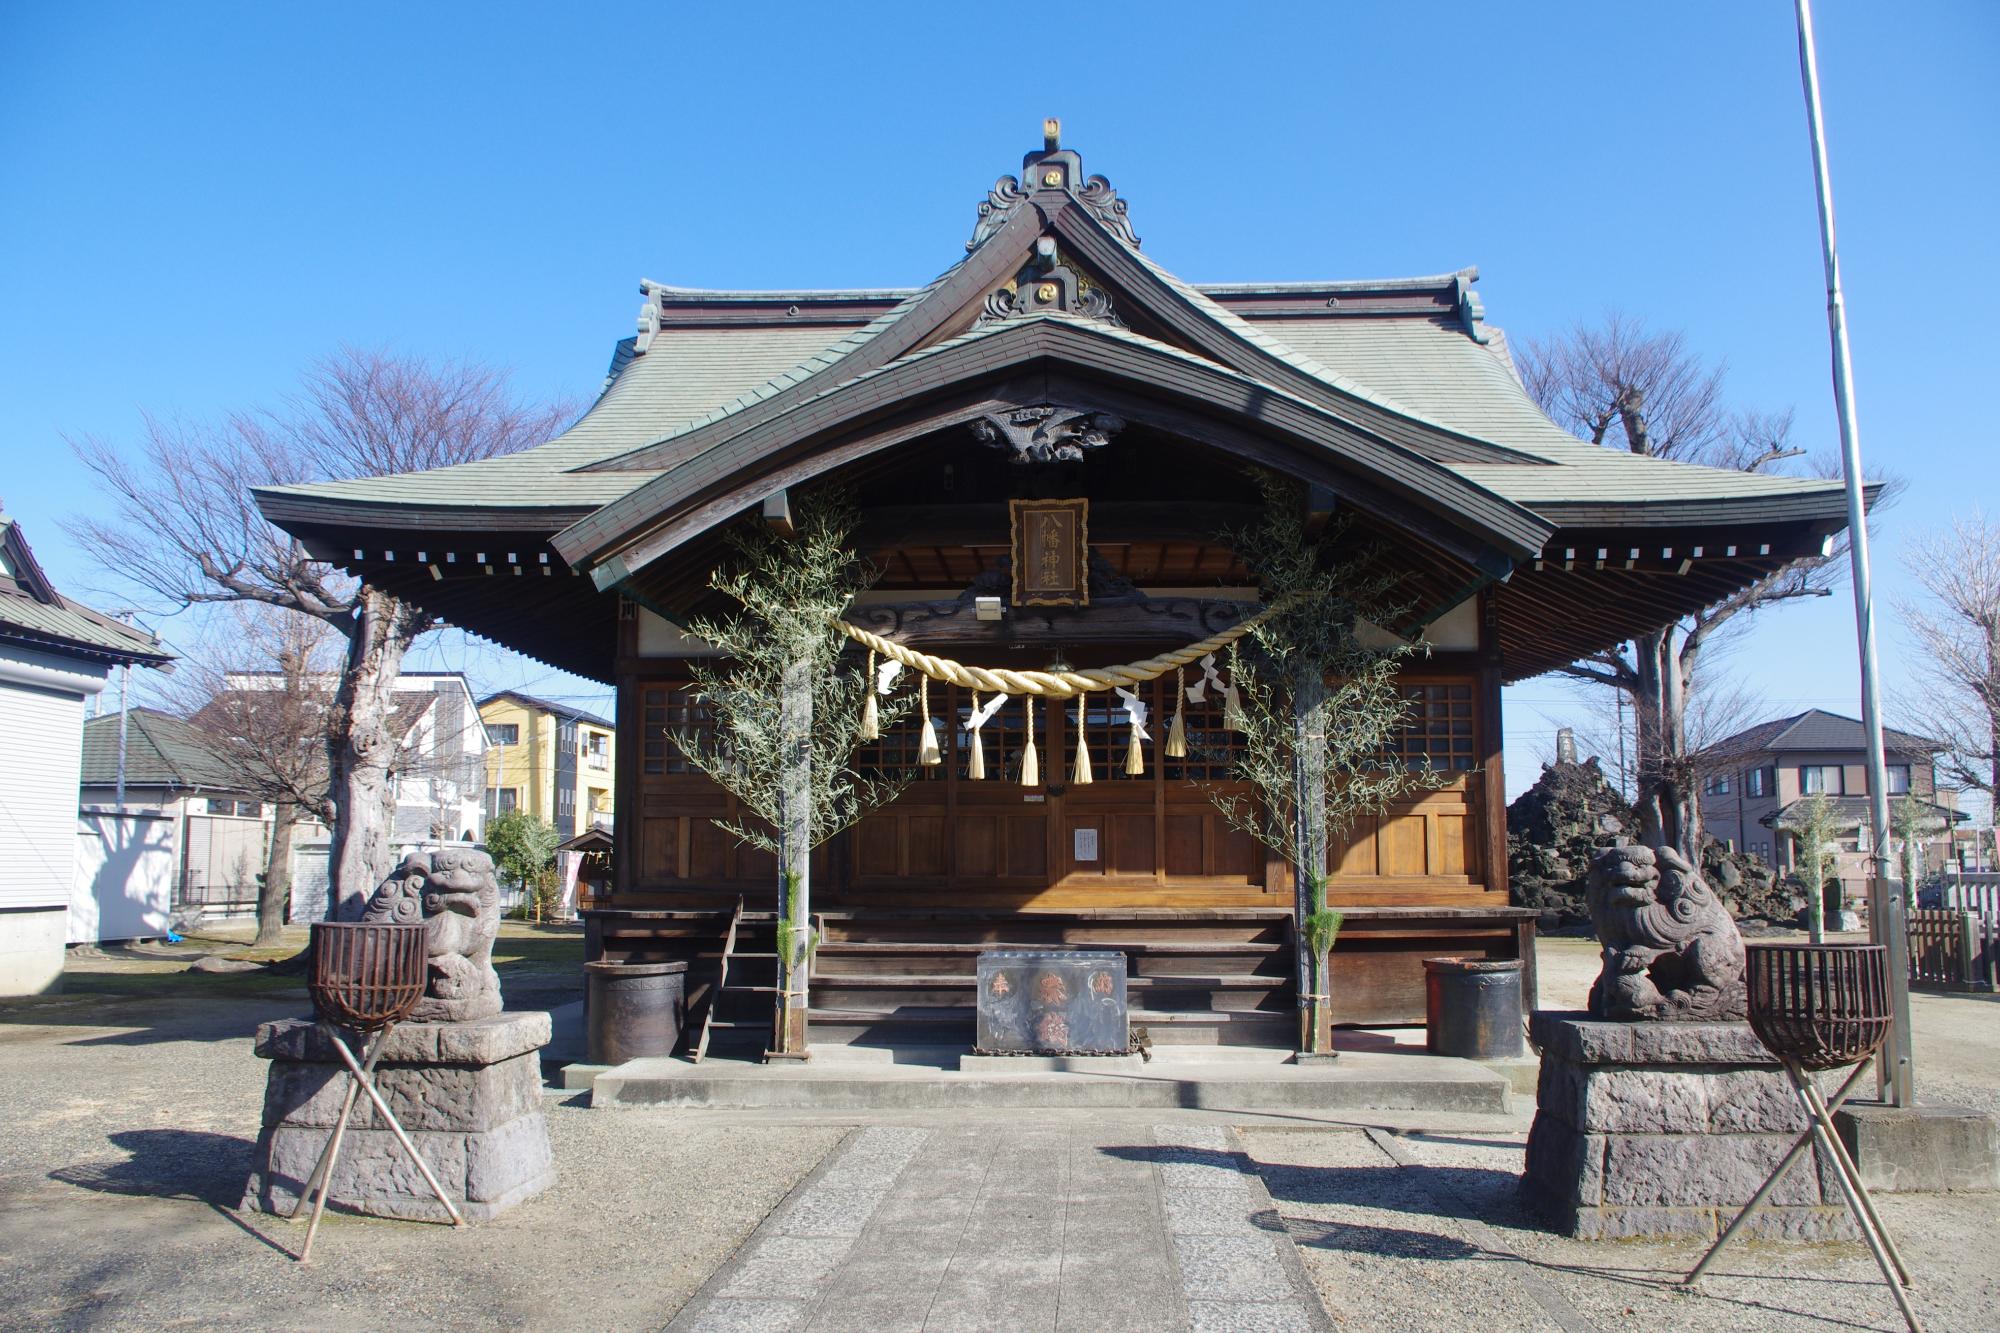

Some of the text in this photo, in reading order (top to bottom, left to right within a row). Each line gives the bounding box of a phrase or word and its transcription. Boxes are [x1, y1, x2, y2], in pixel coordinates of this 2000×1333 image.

[1040, 513, 1063, 586] 八幡神社
[992, 972, 1010, 999] 奉
